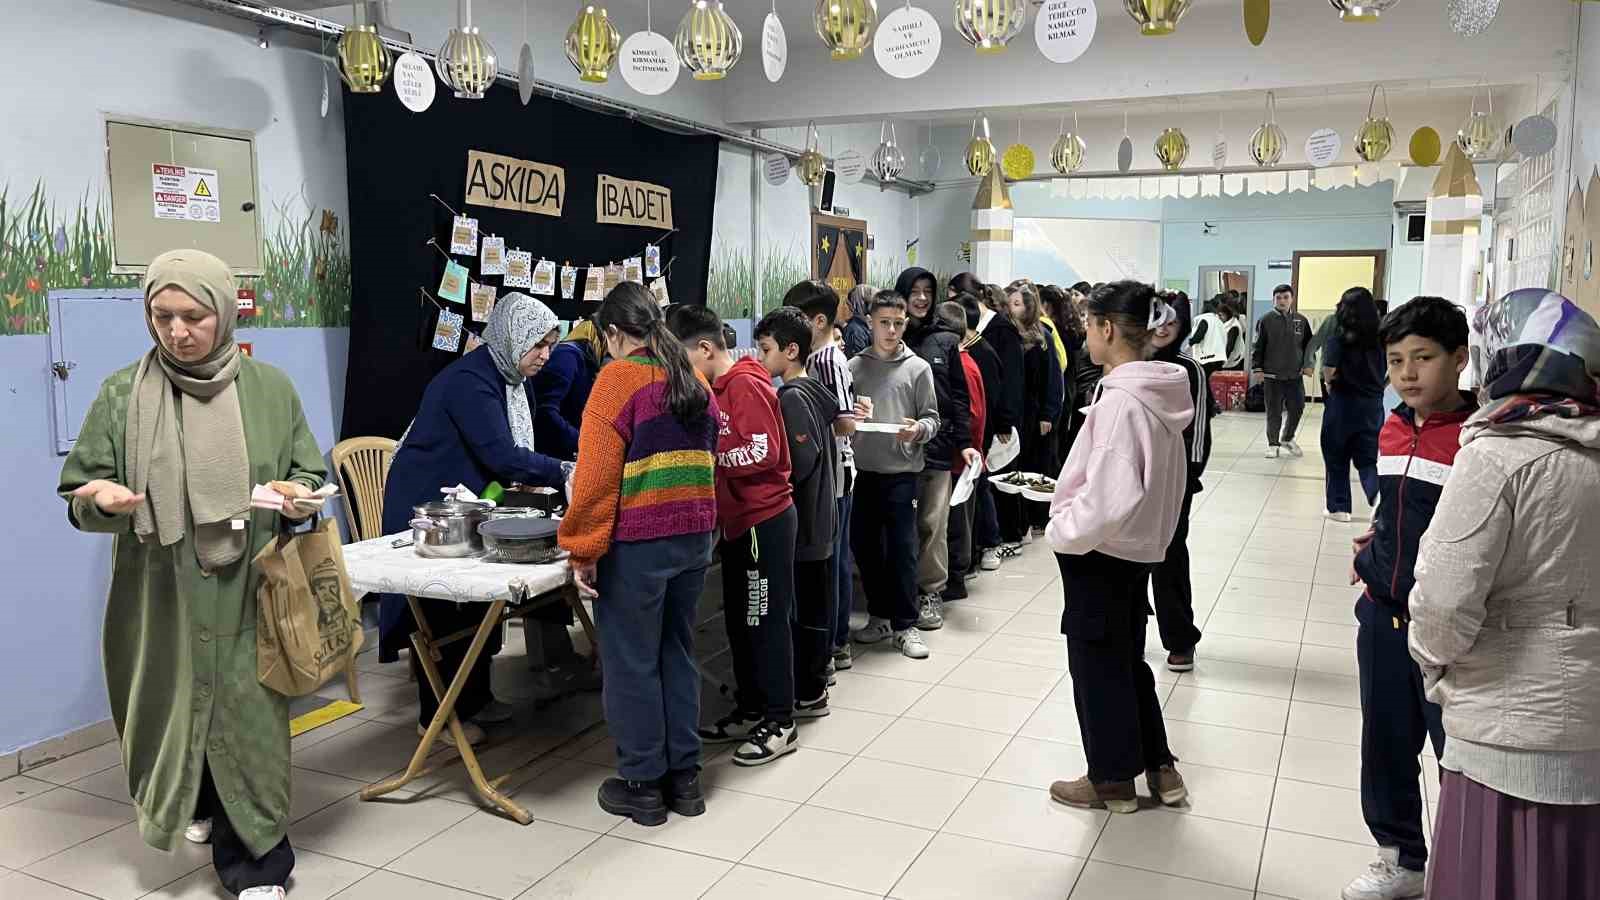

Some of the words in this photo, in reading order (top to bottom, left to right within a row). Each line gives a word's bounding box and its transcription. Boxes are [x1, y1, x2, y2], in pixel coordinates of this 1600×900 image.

[467, 158, 560, 209] ASKIDA
[602, 175, 668, 223] İBADET
[746, 569, 760, 626] BRUINS
[760, 578, 768, 616] BOSTON
